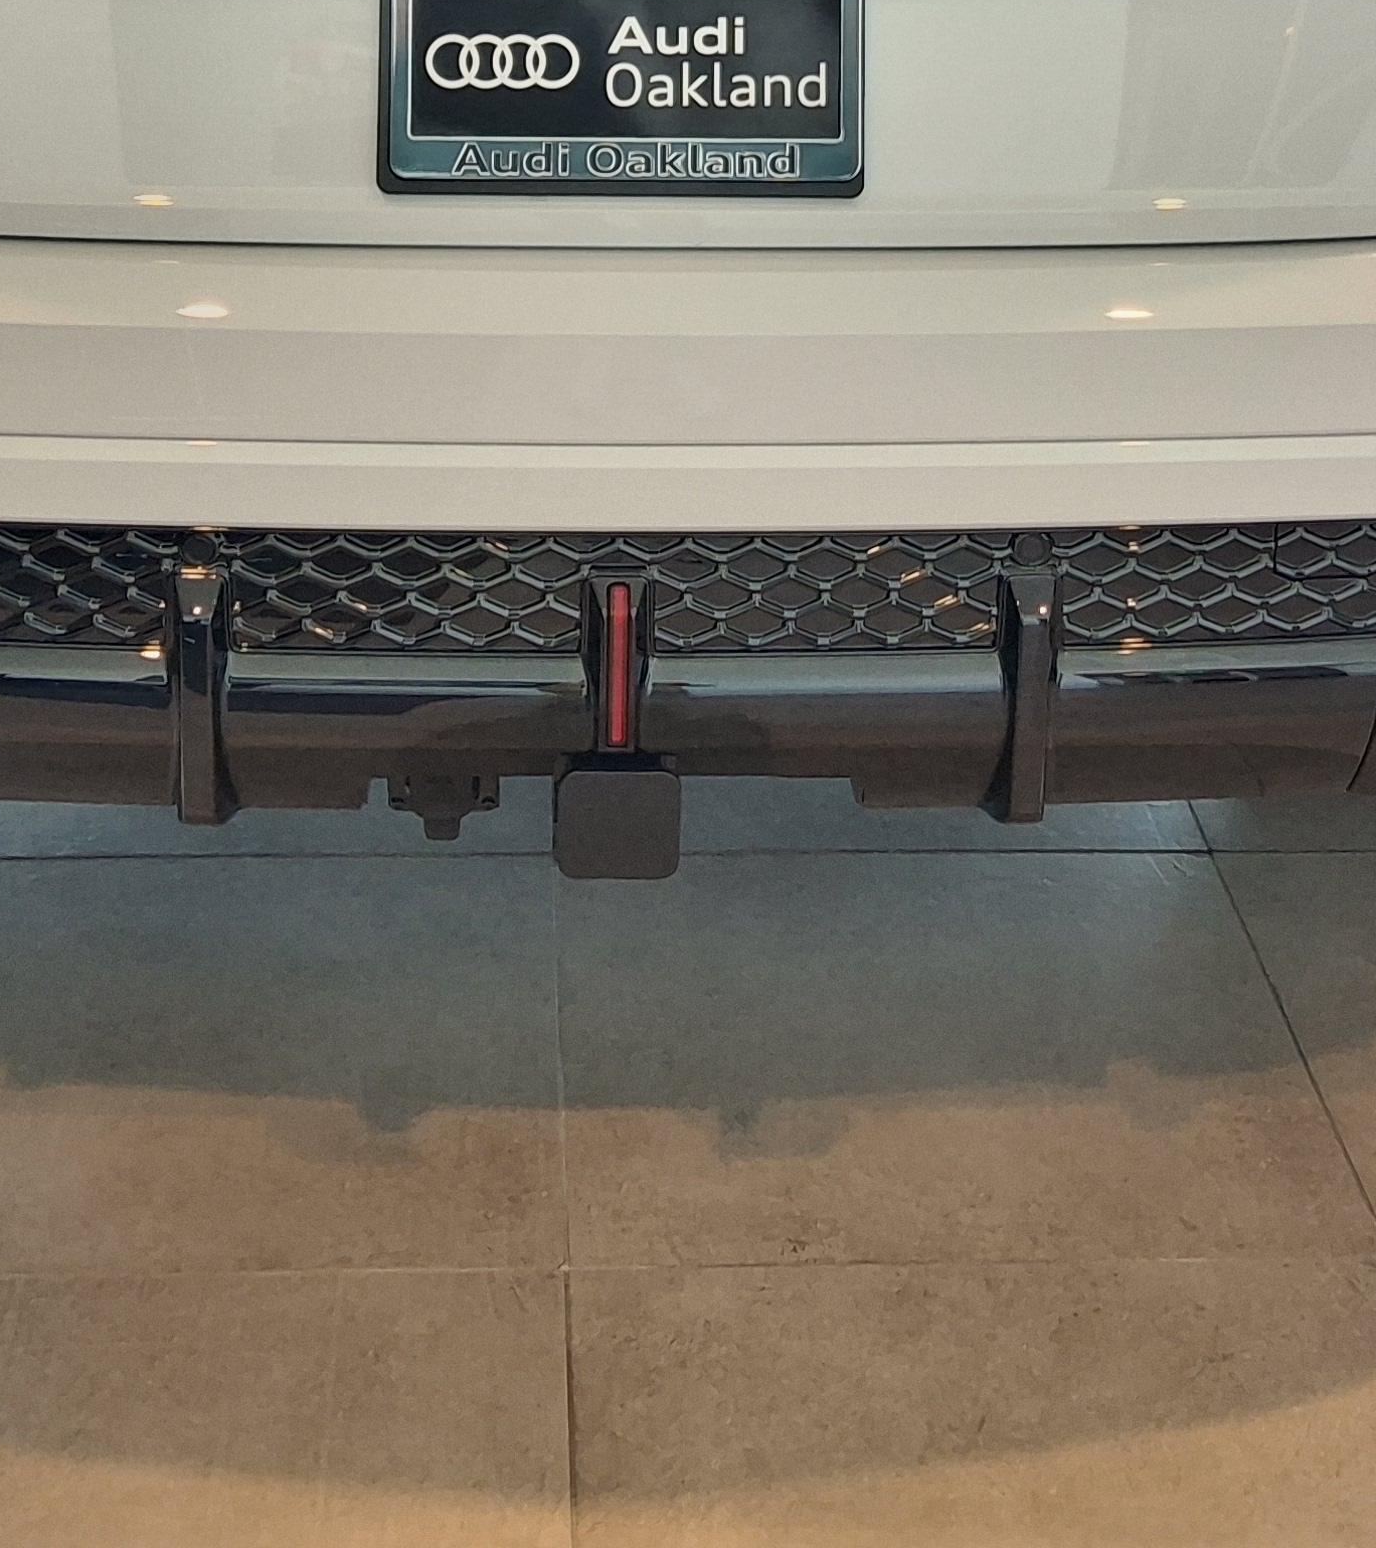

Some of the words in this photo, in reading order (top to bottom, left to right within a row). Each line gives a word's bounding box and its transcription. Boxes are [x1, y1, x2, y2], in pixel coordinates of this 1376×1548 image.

[607, 16, 746, 56] Audi
[604, 61, 828, 109] Oakland
[451, 141, 569, 178] Audi
[586, 142, 801, 179] Oakland
